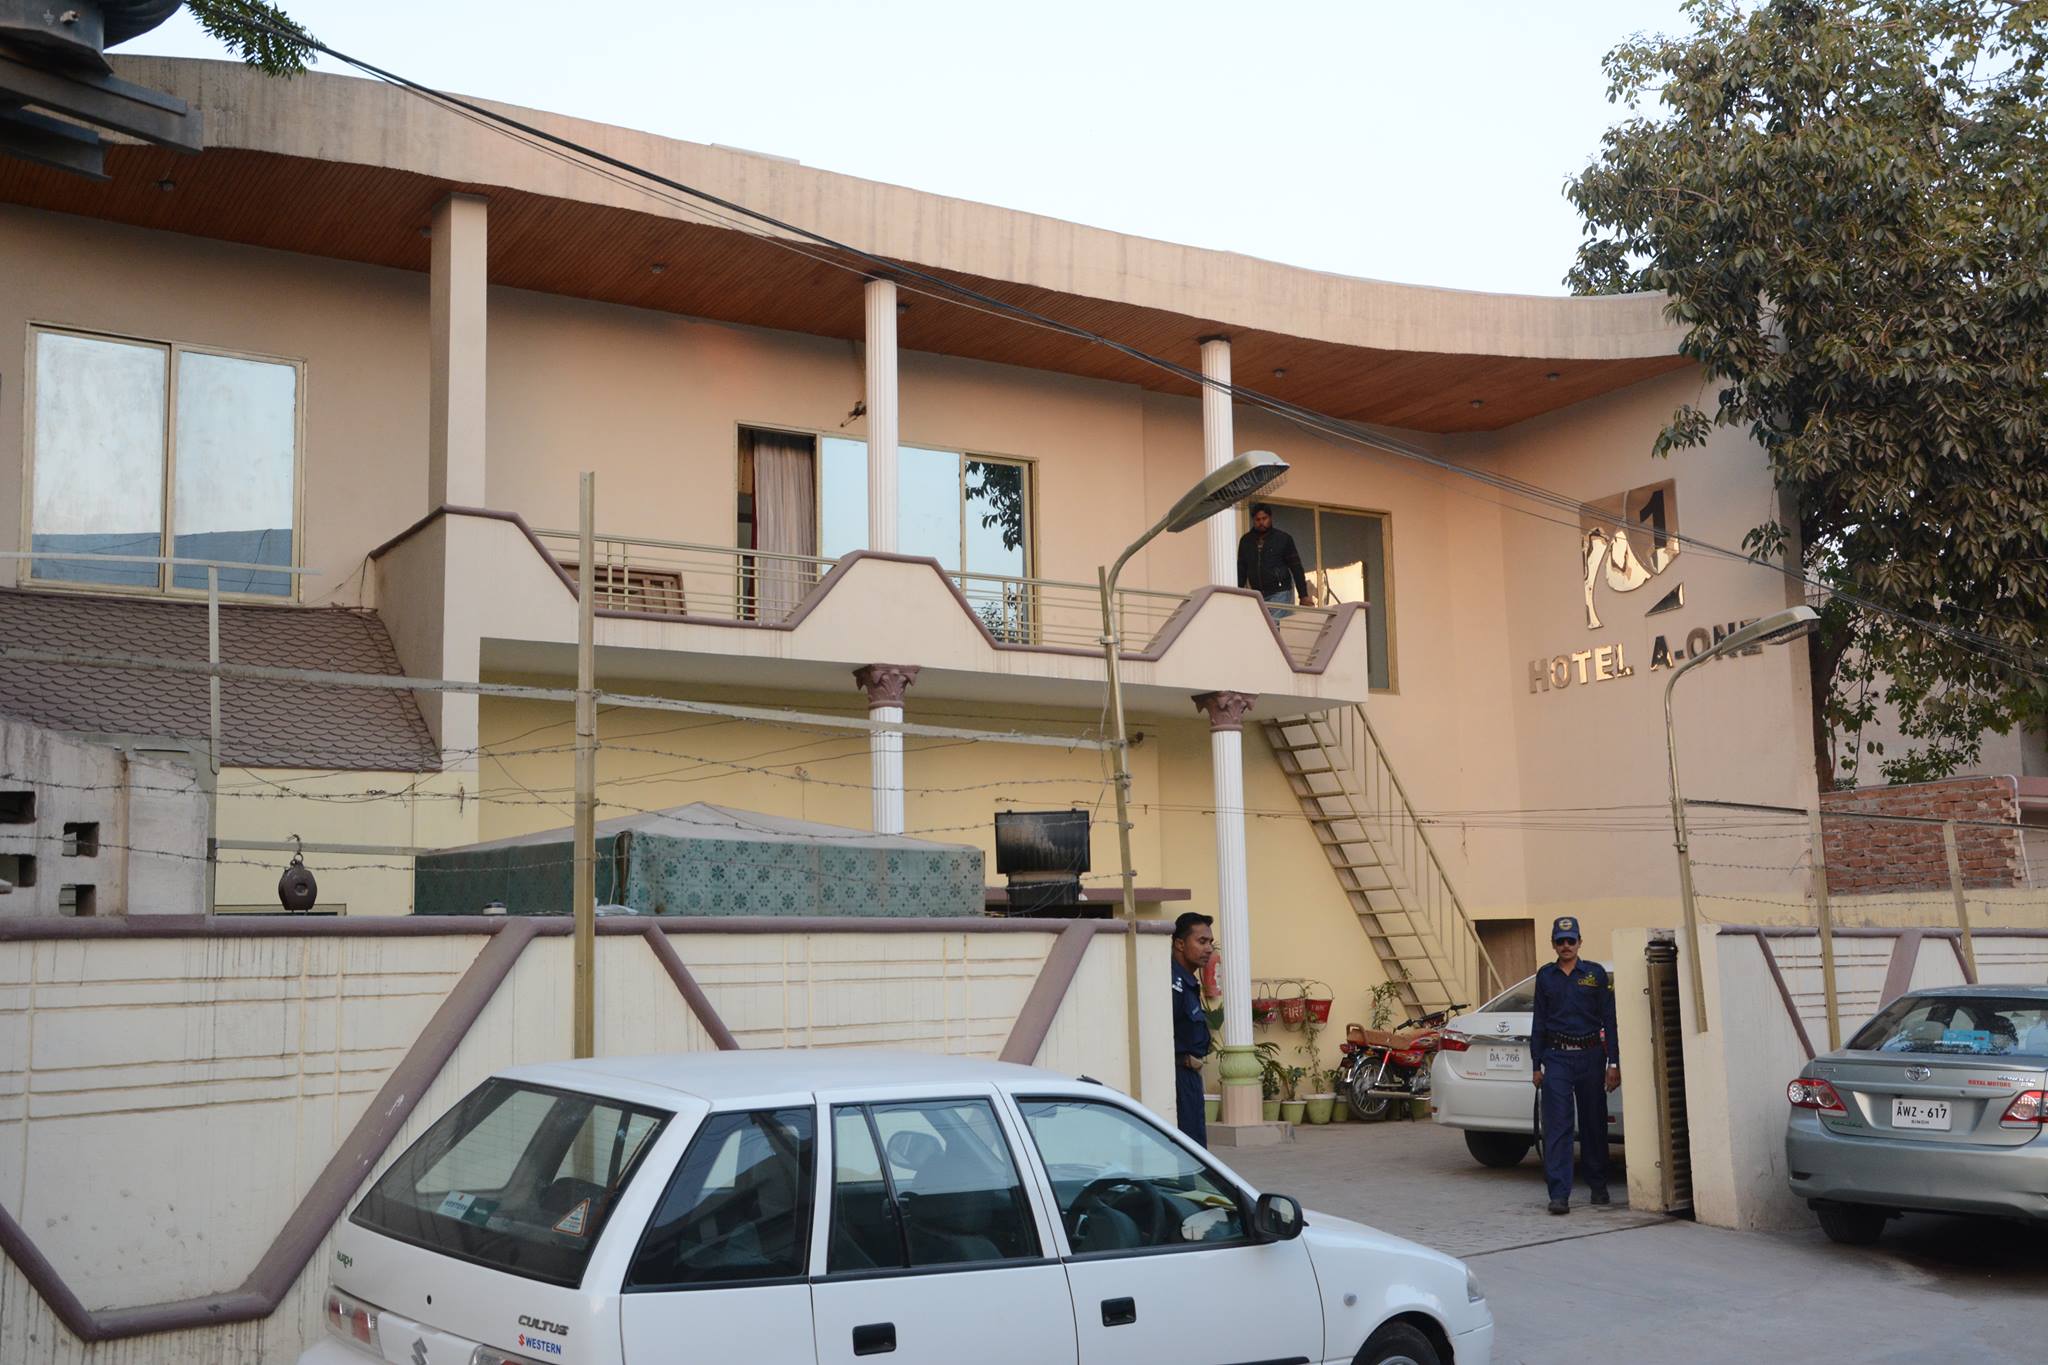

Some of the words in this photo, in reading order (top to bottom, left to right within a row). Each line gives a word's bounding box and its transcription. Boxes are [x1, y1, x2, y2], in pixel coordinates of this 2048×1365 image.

[1528, 643, 1634, 693] HOTEL
[518, 1314, 569, 1336] CULTUS
[526, 1336, 562, 1355] WESTERN
